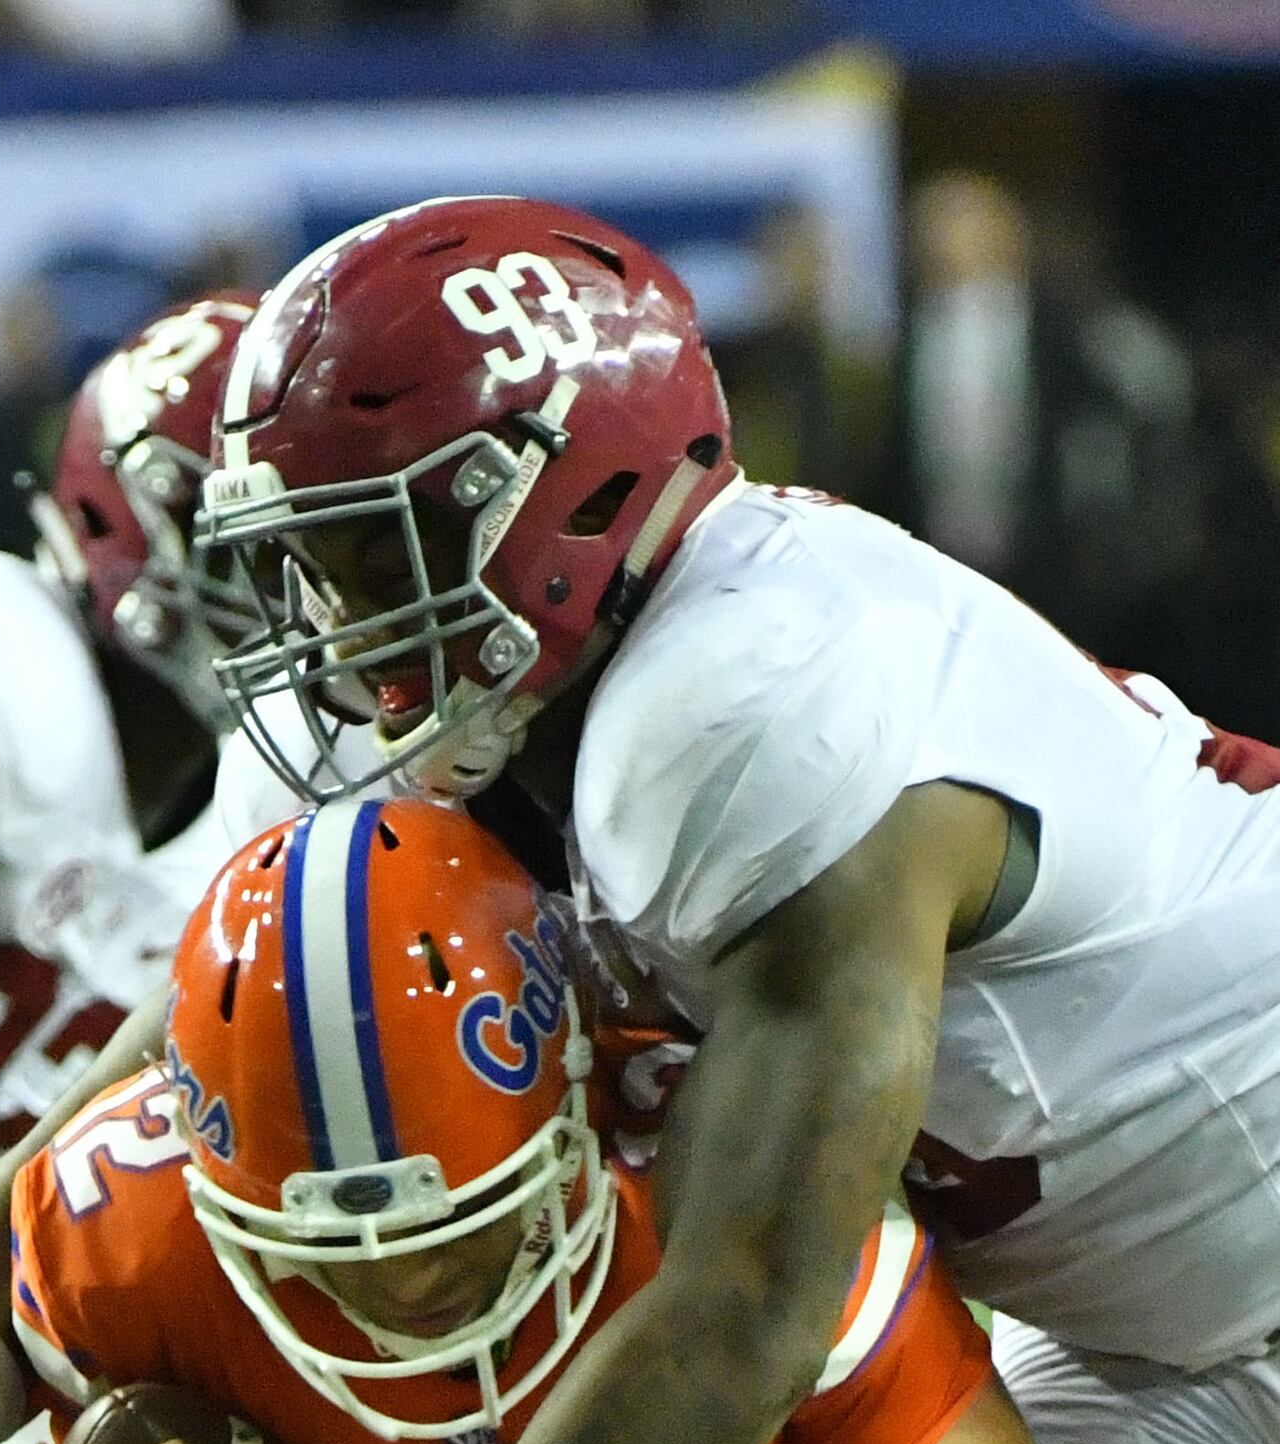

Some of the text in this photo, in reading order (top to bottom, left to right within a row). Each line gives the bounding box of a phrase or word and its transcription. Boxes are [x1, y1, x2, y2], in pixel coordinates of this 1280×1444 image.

[441, 251, 598, 383] 93
[480, 501, 515, 557] MSON
[52, 1062, 190, 1222] 12
